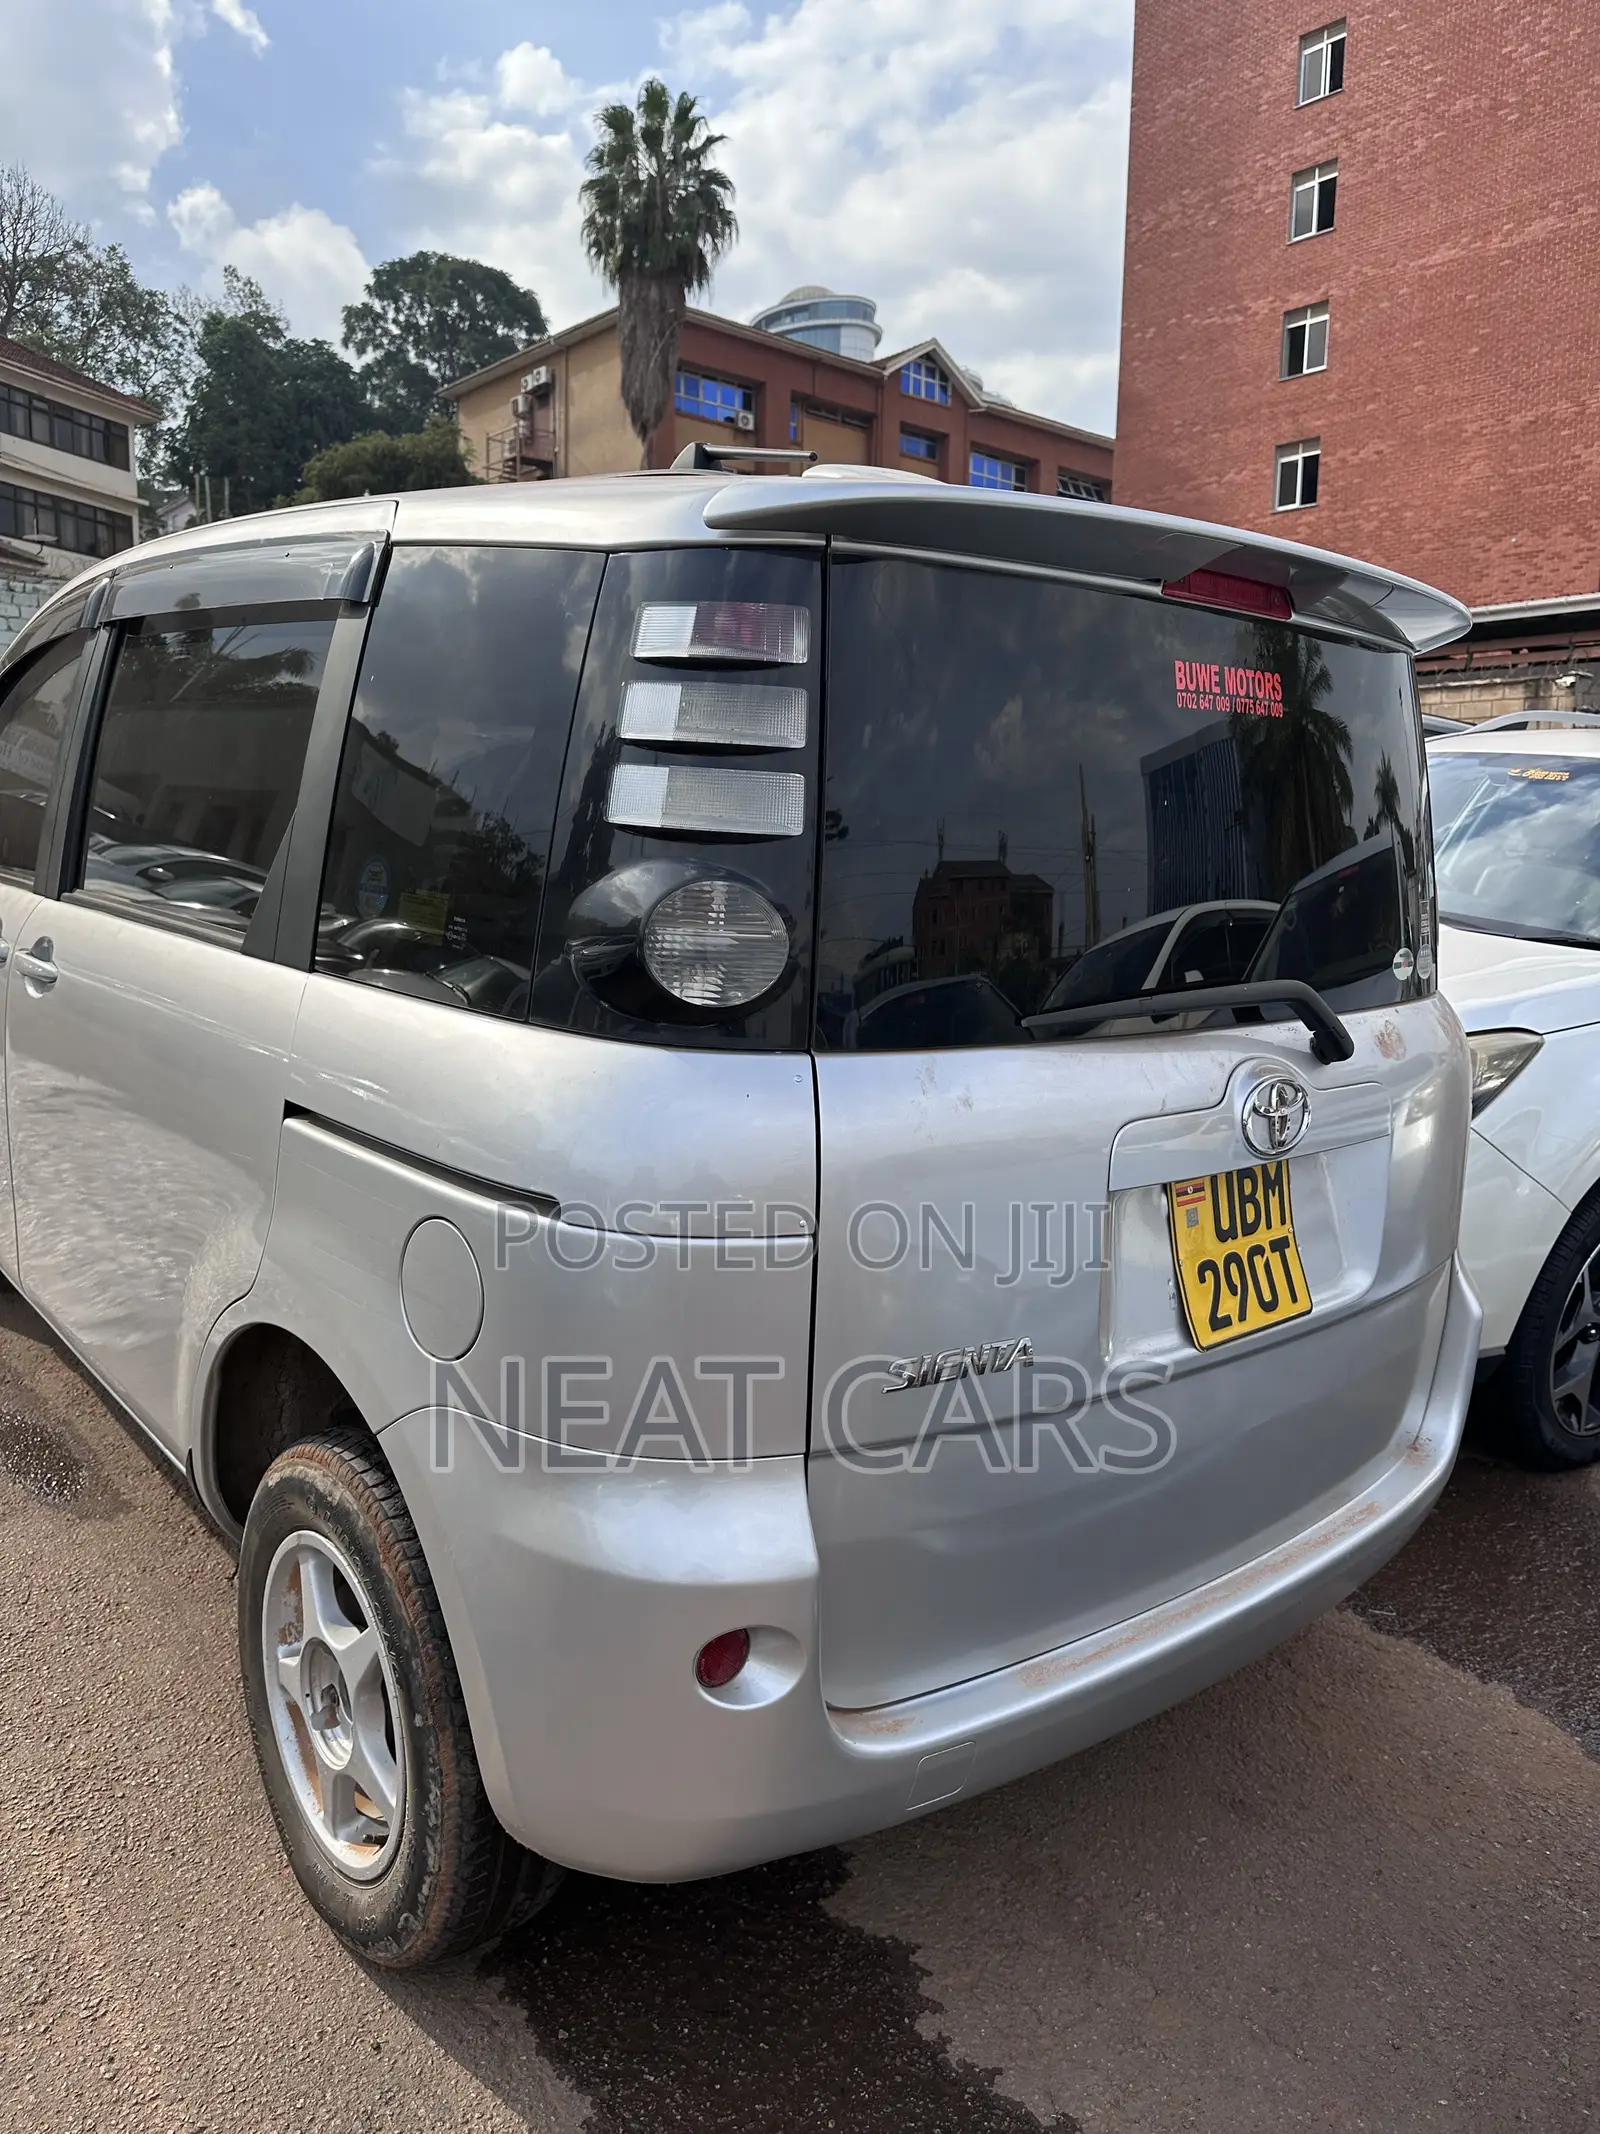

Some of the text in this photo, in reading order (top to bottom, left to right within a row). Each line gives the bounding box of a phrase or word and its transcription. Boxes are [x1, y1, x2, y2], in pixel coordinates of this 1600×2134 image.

[1174, 660, 1283, 702] BUWE MOTORS
[1176, 692, 1198, 709] 0702
[1199, 694, 1214, 710] 647
[1215, 697, 1231, 712] 009
[1236, 698, 1255, 715] 0775
[1255, 701, 1269, 716] 647
[1270, 702, 1284, 718] 009
[1210, 1160, 1287, 1243] UBM
[1197, 1235, 1299, 1332] 290T
[881, 1336, 1034, 1394] SIENTA
